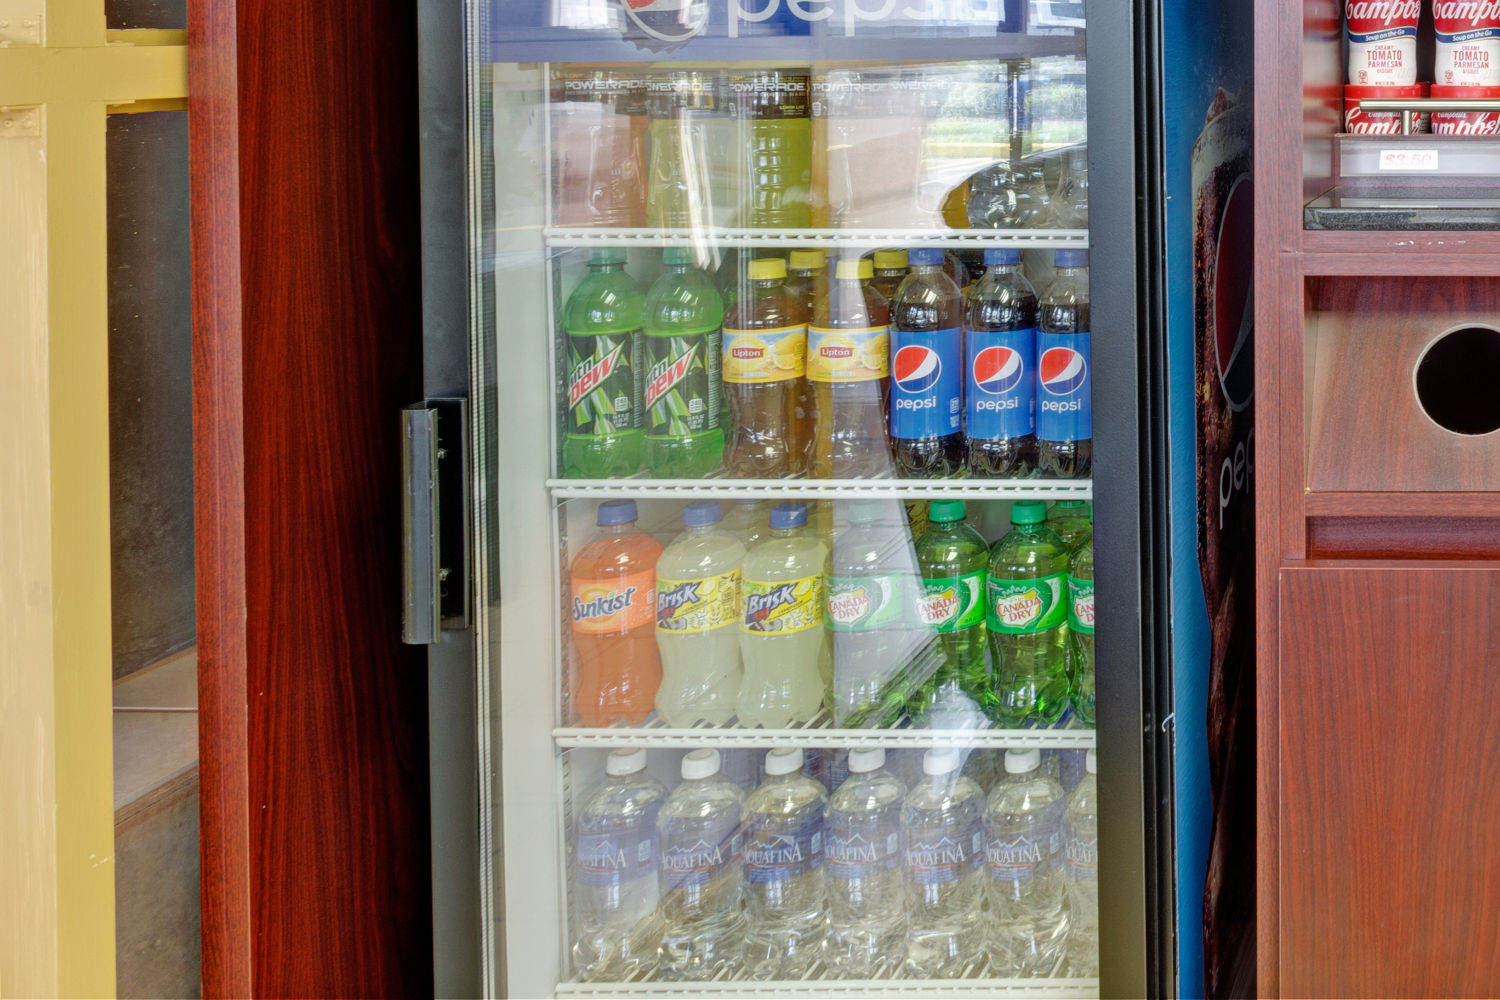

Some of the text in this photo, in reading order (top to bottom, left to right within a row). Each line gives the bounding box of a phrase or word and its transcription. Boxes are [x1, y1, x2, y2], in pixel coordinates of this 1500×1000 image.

[1365, 32, 1379, 42] Soup
[1452, 33, 1466, 42] Soup
[1367, 50, 1402, 62] TOMATO
[1453, 50, 1489, 62] TOMATO
[1367, 60, 1403, 68] PARMESAN
[1454, 61, 1490, 69] PARMESAN
[729, 82, 805, 92] POWERADE
[1384, 153, 1433, 167] $3.50
[734, 349, 762, 359] Lipton
[820, 347, 851, 359] Lipton
[896, 396, 937, 411] pepsi
[976, 397, 1019, 413] pepsi
[1041, 398, 1082, 413] pepsi
[573, 587, 636, 622] Sunkist
[828, 595, 870, 613] CANADA
[996, 596, 1043, 614] CANADA
[838, 606, 861, 621] DRY
[927, 607, 952, 621] DRY
[1008, 608, 1033, 622] DRY
[905, 844, 965, 867] AQUAFINA
